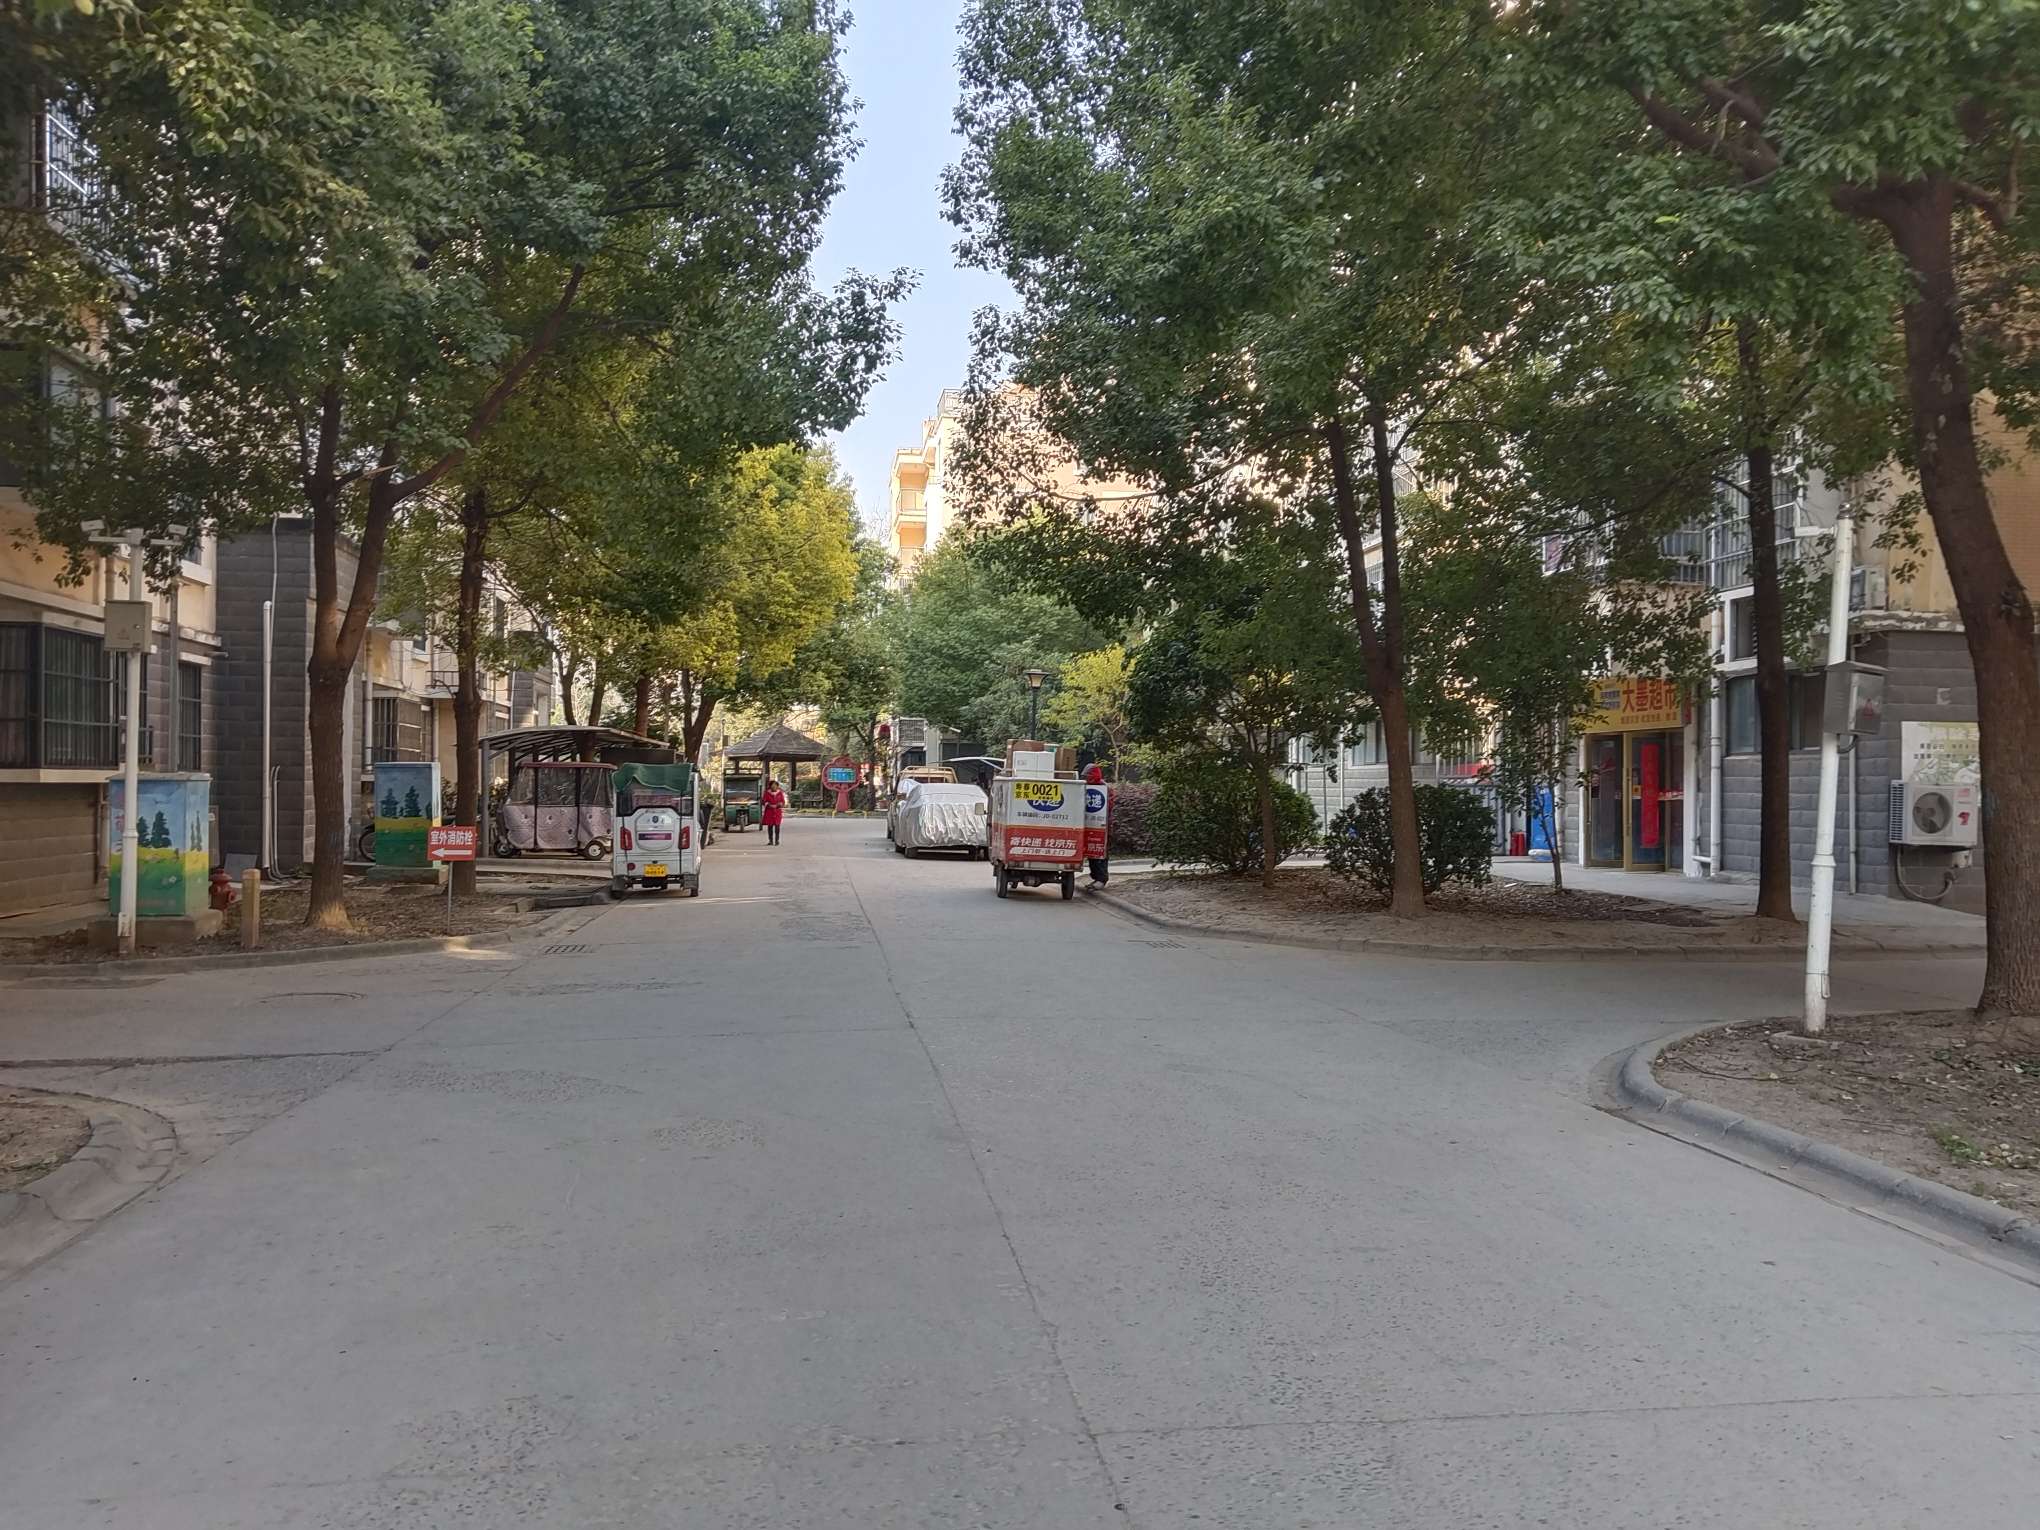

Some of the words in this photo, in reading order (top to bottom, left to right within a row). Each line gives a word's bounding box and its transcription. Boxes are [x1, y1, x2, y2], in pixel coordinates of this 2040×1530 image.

[1032, 784, 1058, 796] 0021
[430, 830, 472, 845] 室外消防栓
[1044, 838, 1076, 848] 找京东
